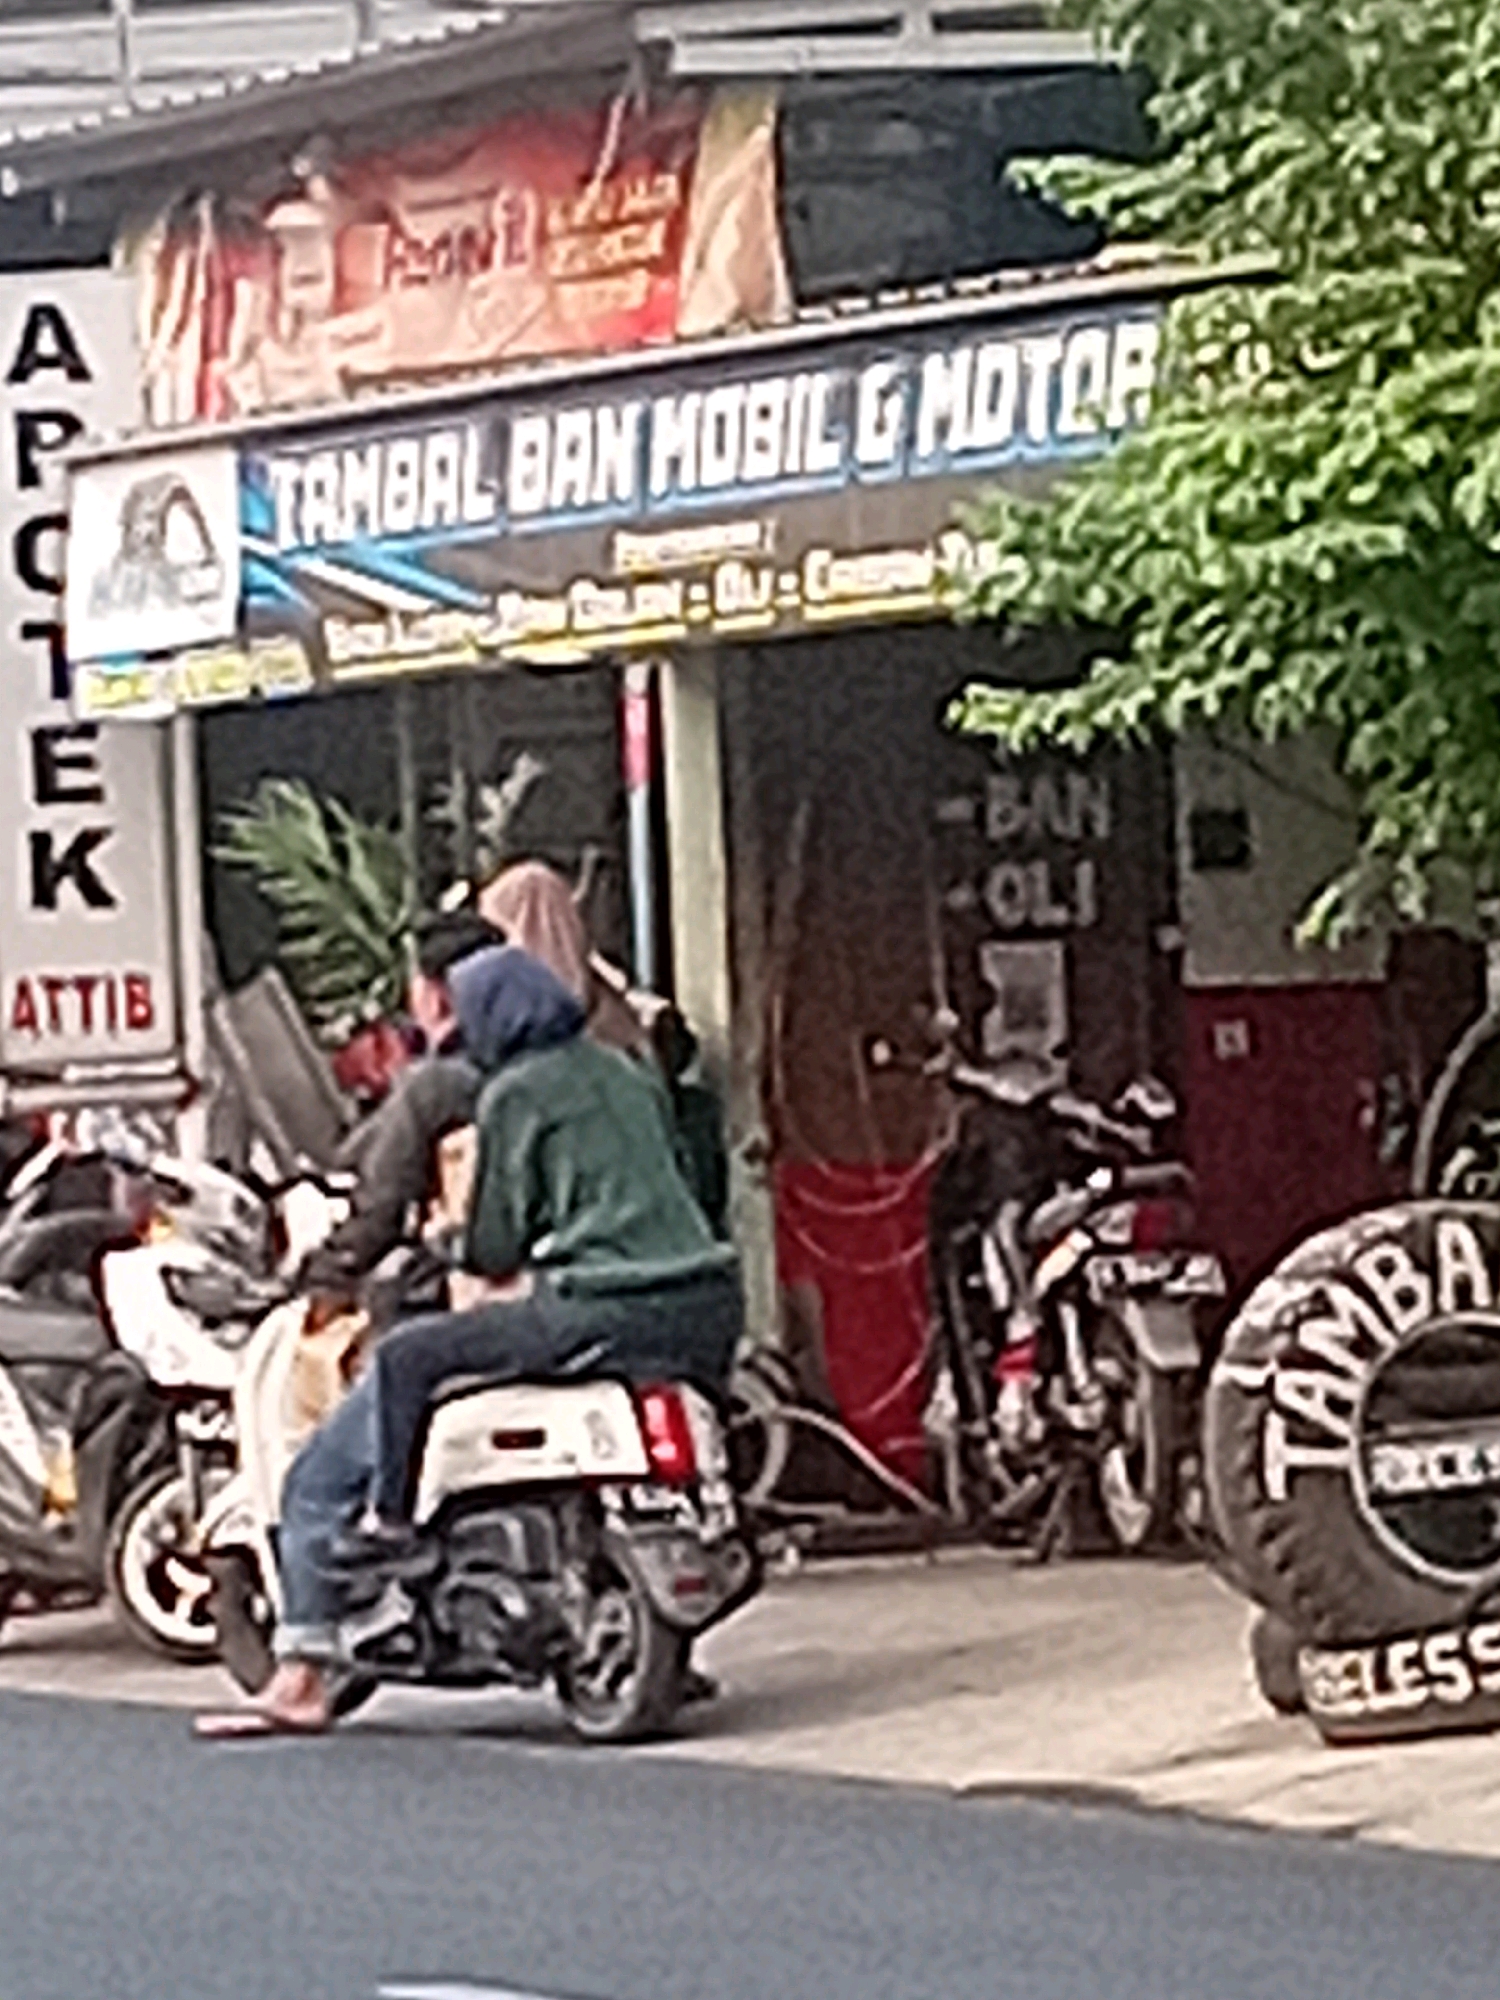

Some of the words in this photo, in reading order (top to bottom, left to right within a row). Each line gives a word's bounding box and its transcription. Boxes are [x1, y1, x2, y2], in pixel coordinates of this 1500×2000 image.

[269, 423, 500, 550] TAMBAL
[506, 401, 645, 516] BAN
[649, 371, 841, 500] MOBIL
[917, 322, 1158, 458] MOTOR
[984, 859, 1097, 927] OLI
